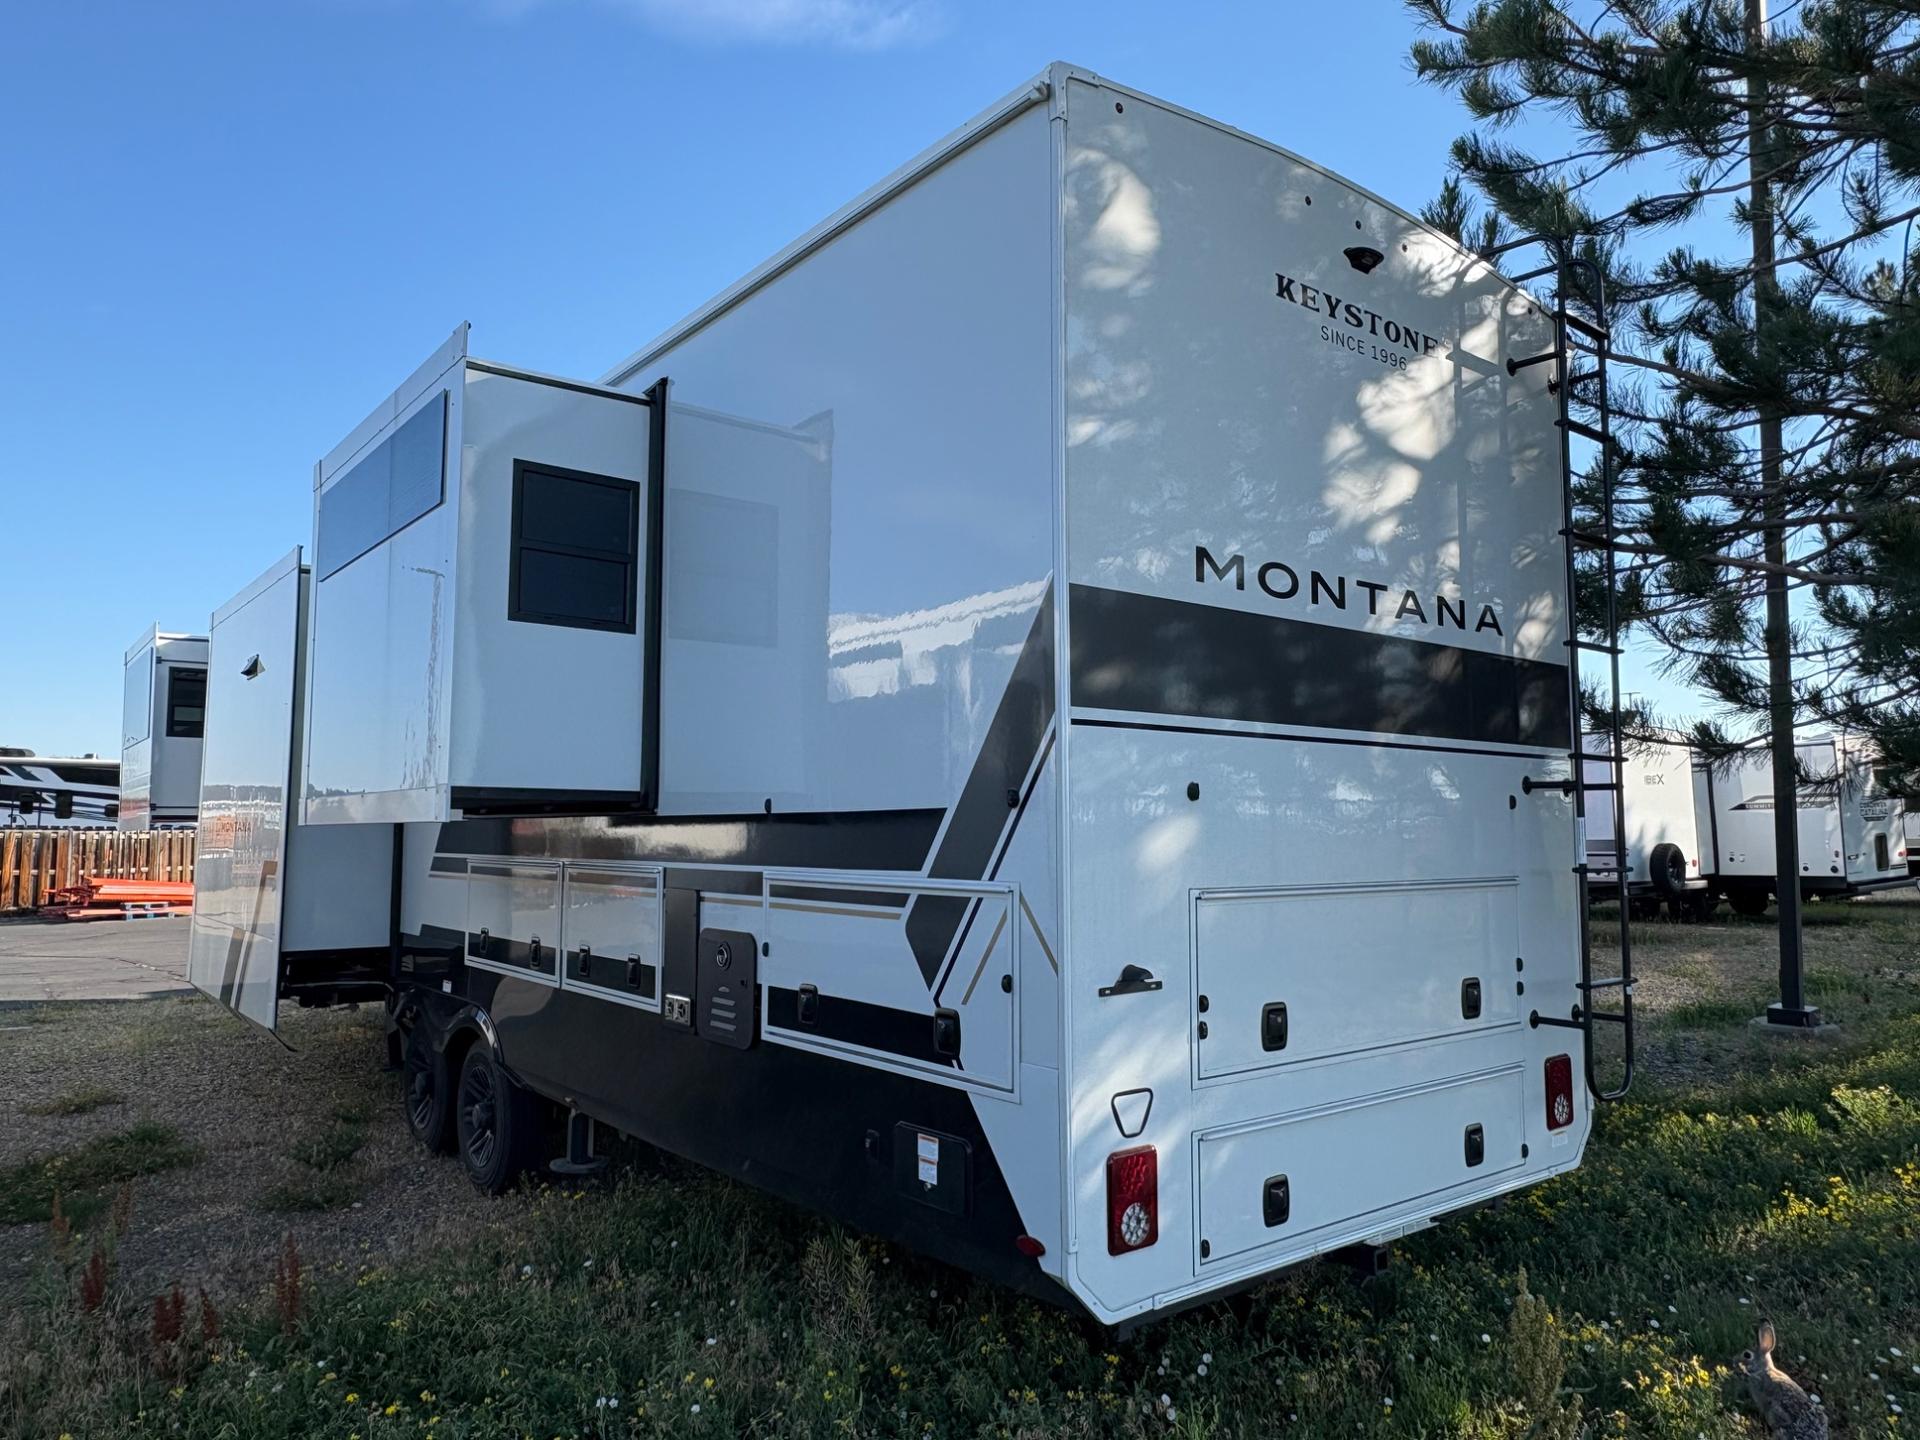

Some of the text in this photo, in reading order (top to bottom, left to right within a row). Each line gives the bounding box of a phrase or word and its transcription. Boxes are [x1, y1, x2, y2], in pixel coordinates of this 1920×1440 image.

[1320, 325, 1407, 371] SINCE 1996
[1195, 545, 1504, 637] MONTANA
